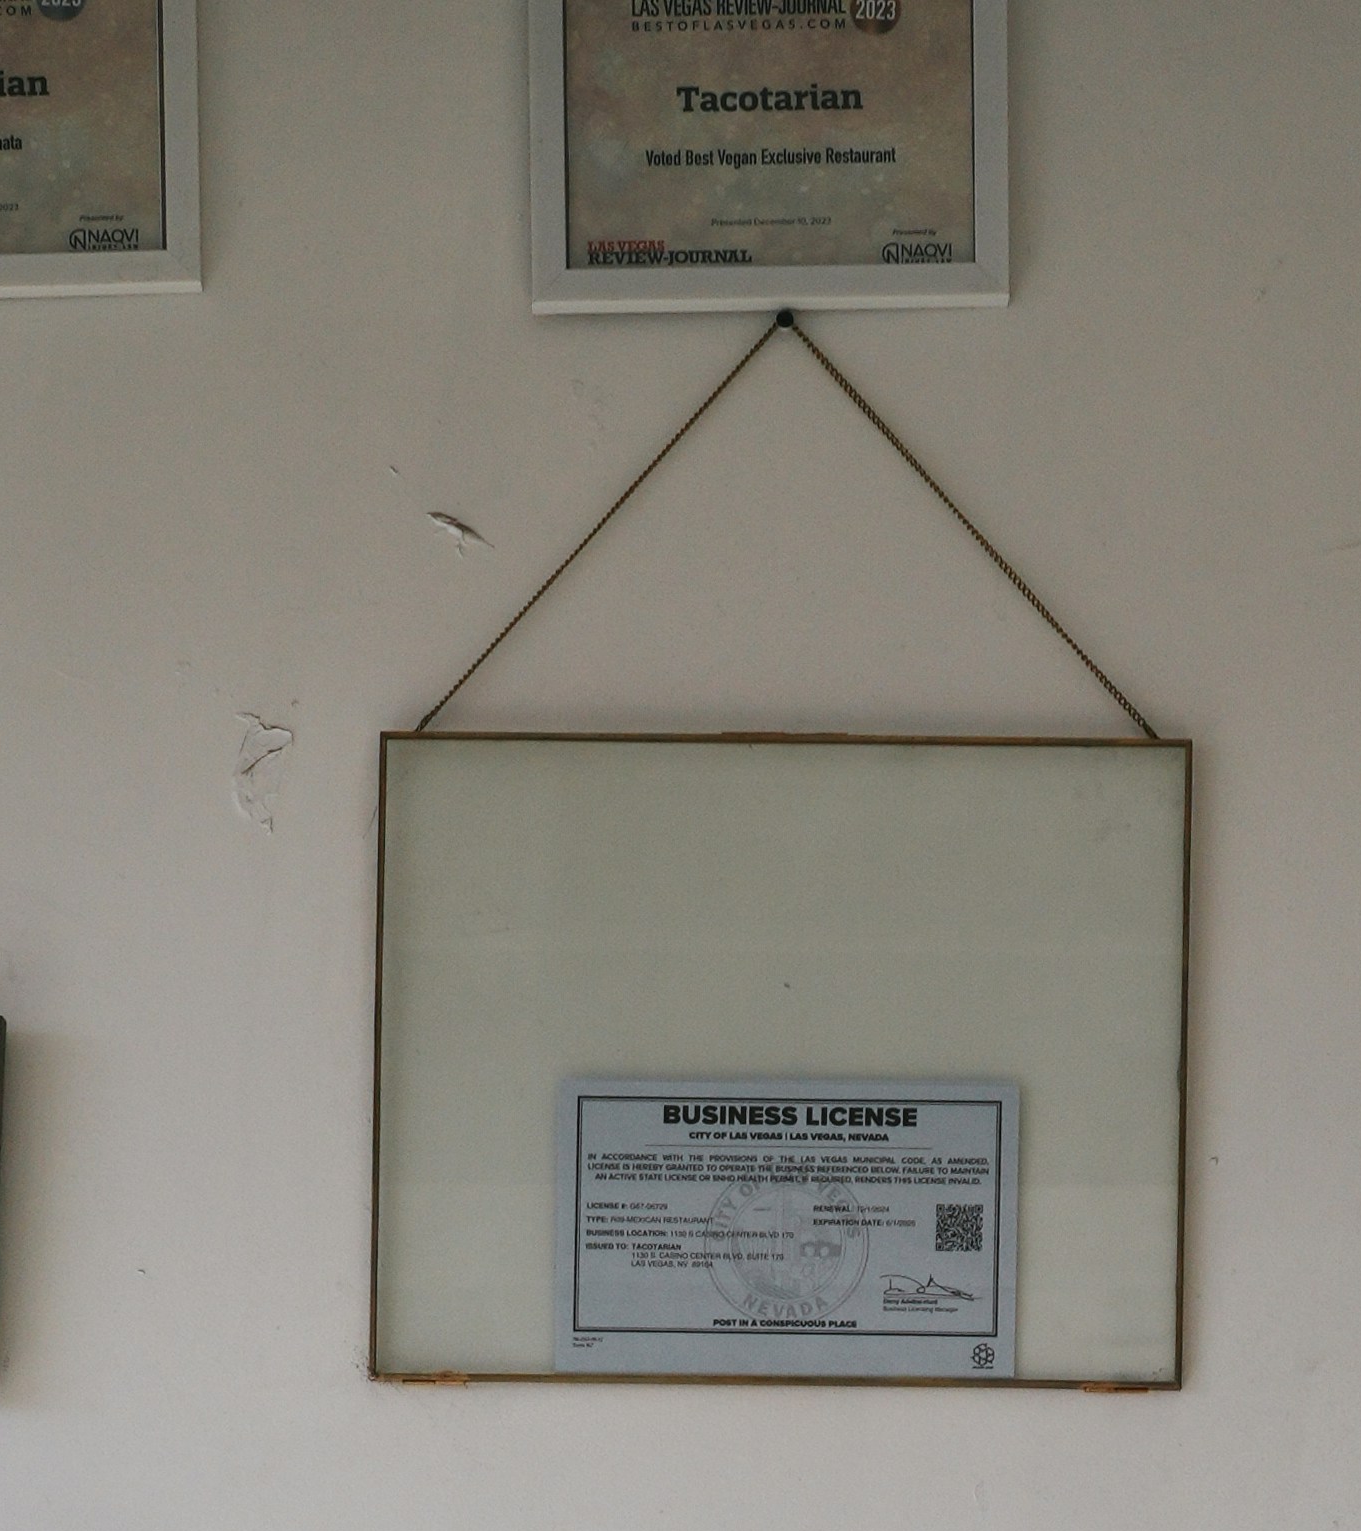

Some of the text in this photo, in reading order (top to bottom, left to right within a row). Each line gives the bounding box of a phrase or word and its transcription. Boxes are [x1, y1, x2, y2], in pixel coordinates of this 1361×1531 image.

[856, 0, 896, 20] 2023
[632, 18, 845, 32] BESTOFLASVEGAS.COM
[677, 83, 863, 112] Tacotarian
[646, 147, 896, 169] Voted Best Vegan Exclusive Restaurant
[588, 240, 664, 254] LAS VEGAS
[588, 248, 752, 265] REVIEW-JOURNAL
[663, 1102, 917, 1127] BUSINESS LICENSE
[688, 1131, 890, 1143] CITY OF LAS VEGAS LAS VEGAS, NEVADA
